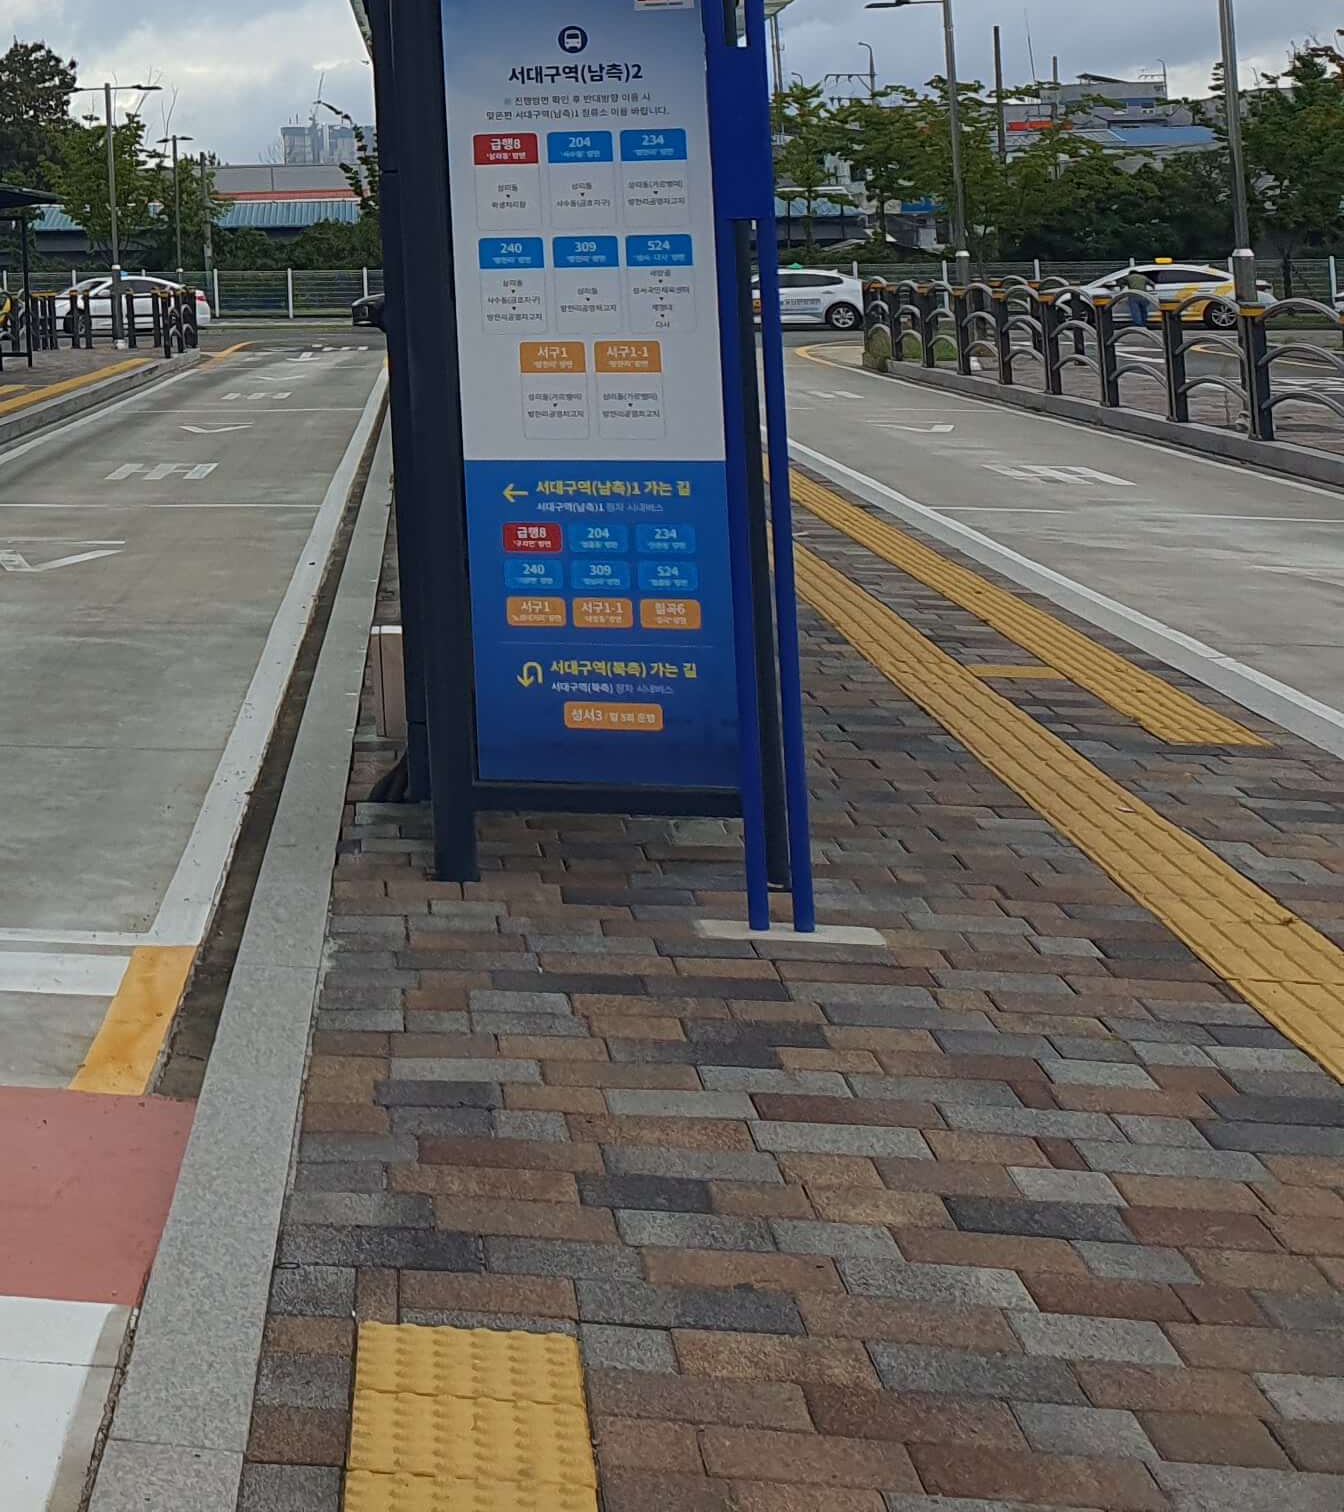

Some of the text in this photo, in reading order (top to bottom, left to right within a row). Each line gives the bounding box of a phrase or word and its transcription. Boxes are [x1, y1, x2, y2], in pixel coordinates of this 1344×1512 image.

[508, 64, 643, 85] 서대구역(남측)2
[490, 138, 521, 151] 급행8
[568, 137, 592, 148] 204
[641, 135, 665, 146] 234
[500, 243, 522, 254] 240
[575, 242, 597, 252] 309
[647, 240, 671, 251] 524
[537, 346, 568, 358] 서구1
[607, 346, 649, 358] 서구1-1
[536, 480, 691, 497] 서대구역(남측)1 가는 길
[517, 526, 678, 540] 급행8 204 234
[522, 563, 680, 577] 240 309 524
[520, 600, 550, 613] 서구1
[581, 601, 624, 614] 서구1-1
[550, 660, 697, 679] 서대구역(북측) 가는 길
